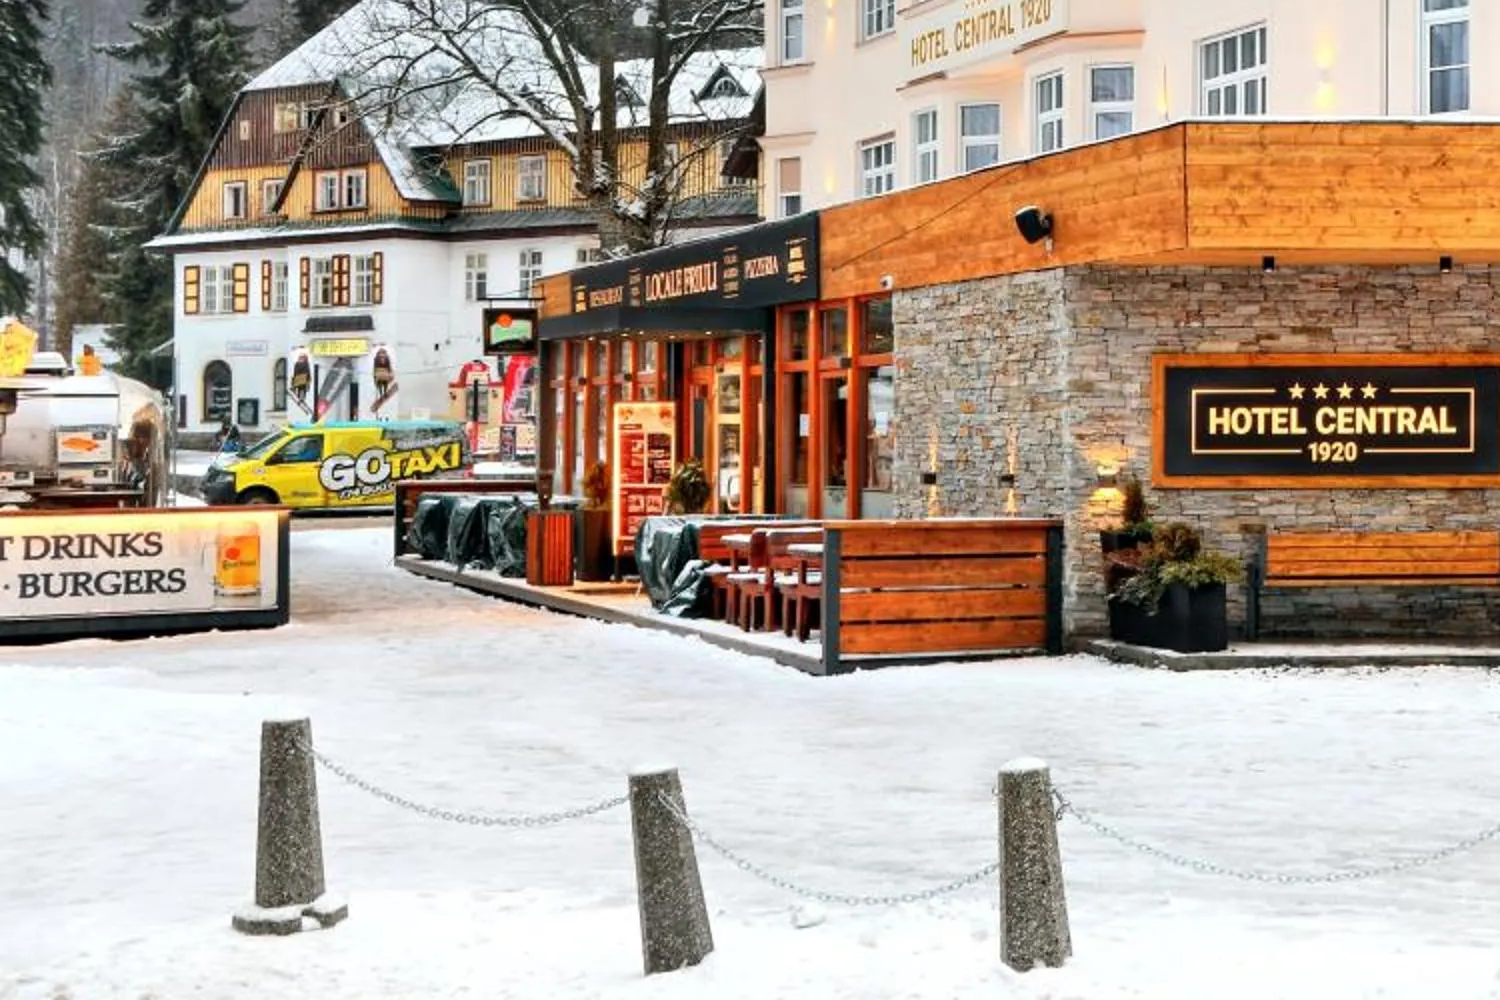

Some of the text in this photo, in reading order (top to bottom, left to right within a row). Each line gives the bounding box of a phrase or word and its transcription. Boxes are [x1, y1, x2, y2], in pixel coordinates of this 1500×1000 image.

[911, 28, 948, 67] HOTEL
[954, 3, 1014, 51] CENTRAL
[645, 269, 682, 301] LOCALE
[684, 261, 718, 295] FRIULI
[1209, 406, 1457, 434] HOTEL CENTRAL
[1308, 441, 1358, 462] 1920
[22, 532, 163, 560] DRINKS
[18, 568, 187, 598] BURGERS
